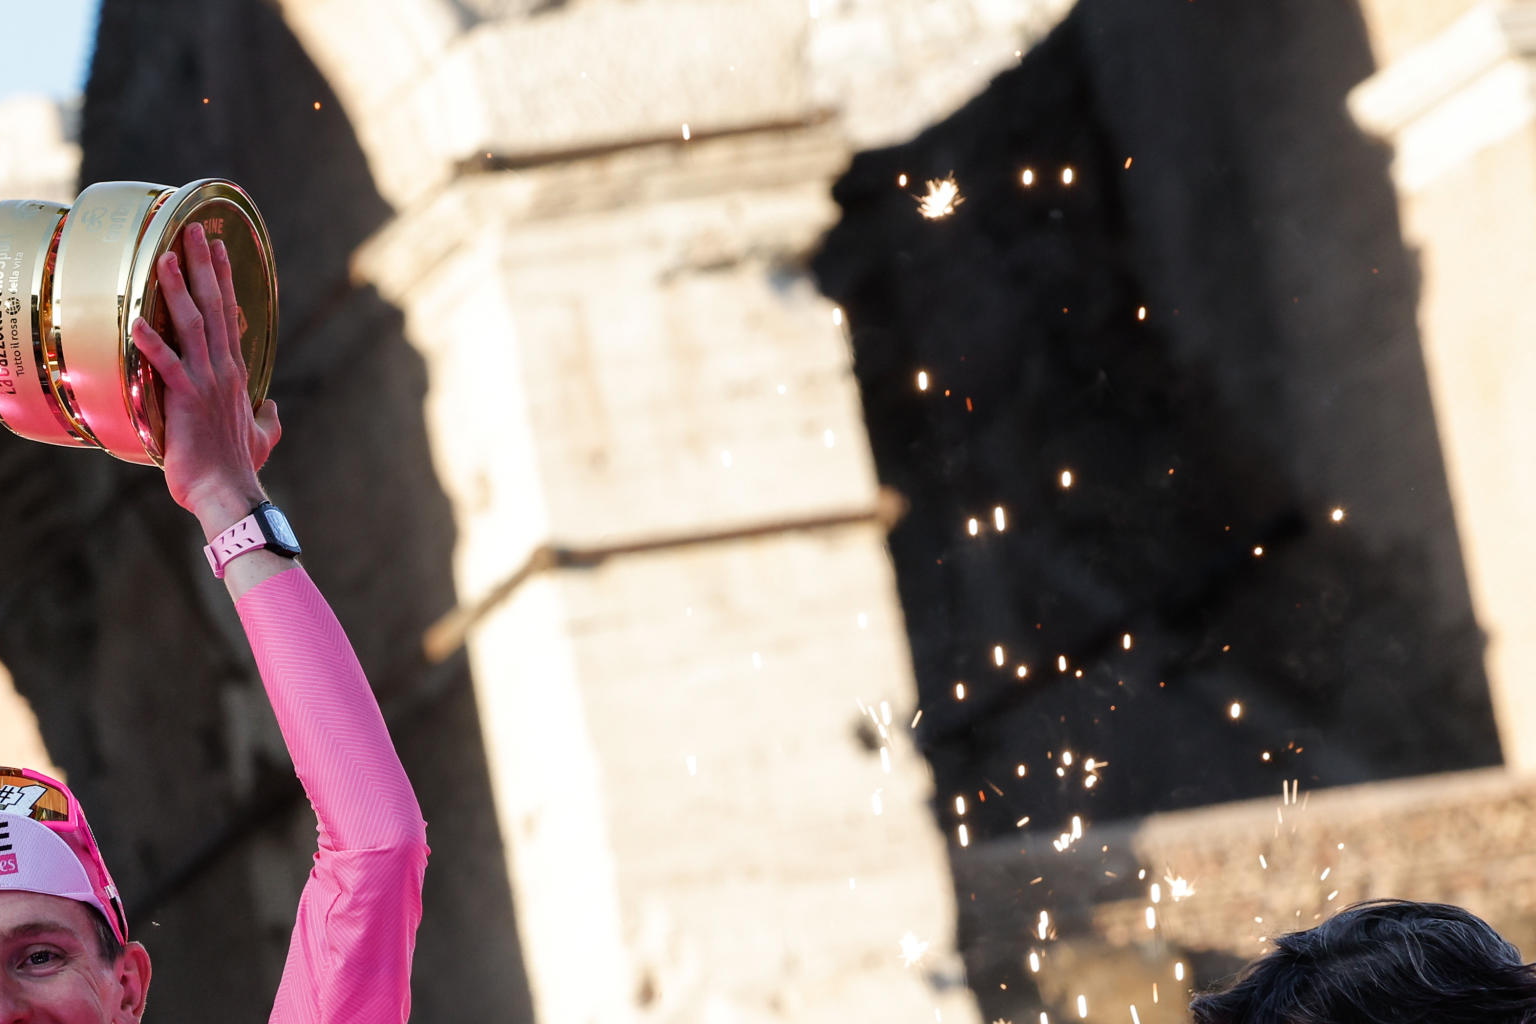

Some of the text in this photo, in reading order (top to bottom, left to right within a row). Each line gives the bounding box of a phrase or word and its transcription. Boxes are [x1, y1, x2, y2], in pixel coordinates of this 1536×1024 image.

[11, 252, 24, 270] vita
[6, 270, 20, 294] della
[8, 318, 19, 341] rosa
[13, 350, 26, 377] Tutto
